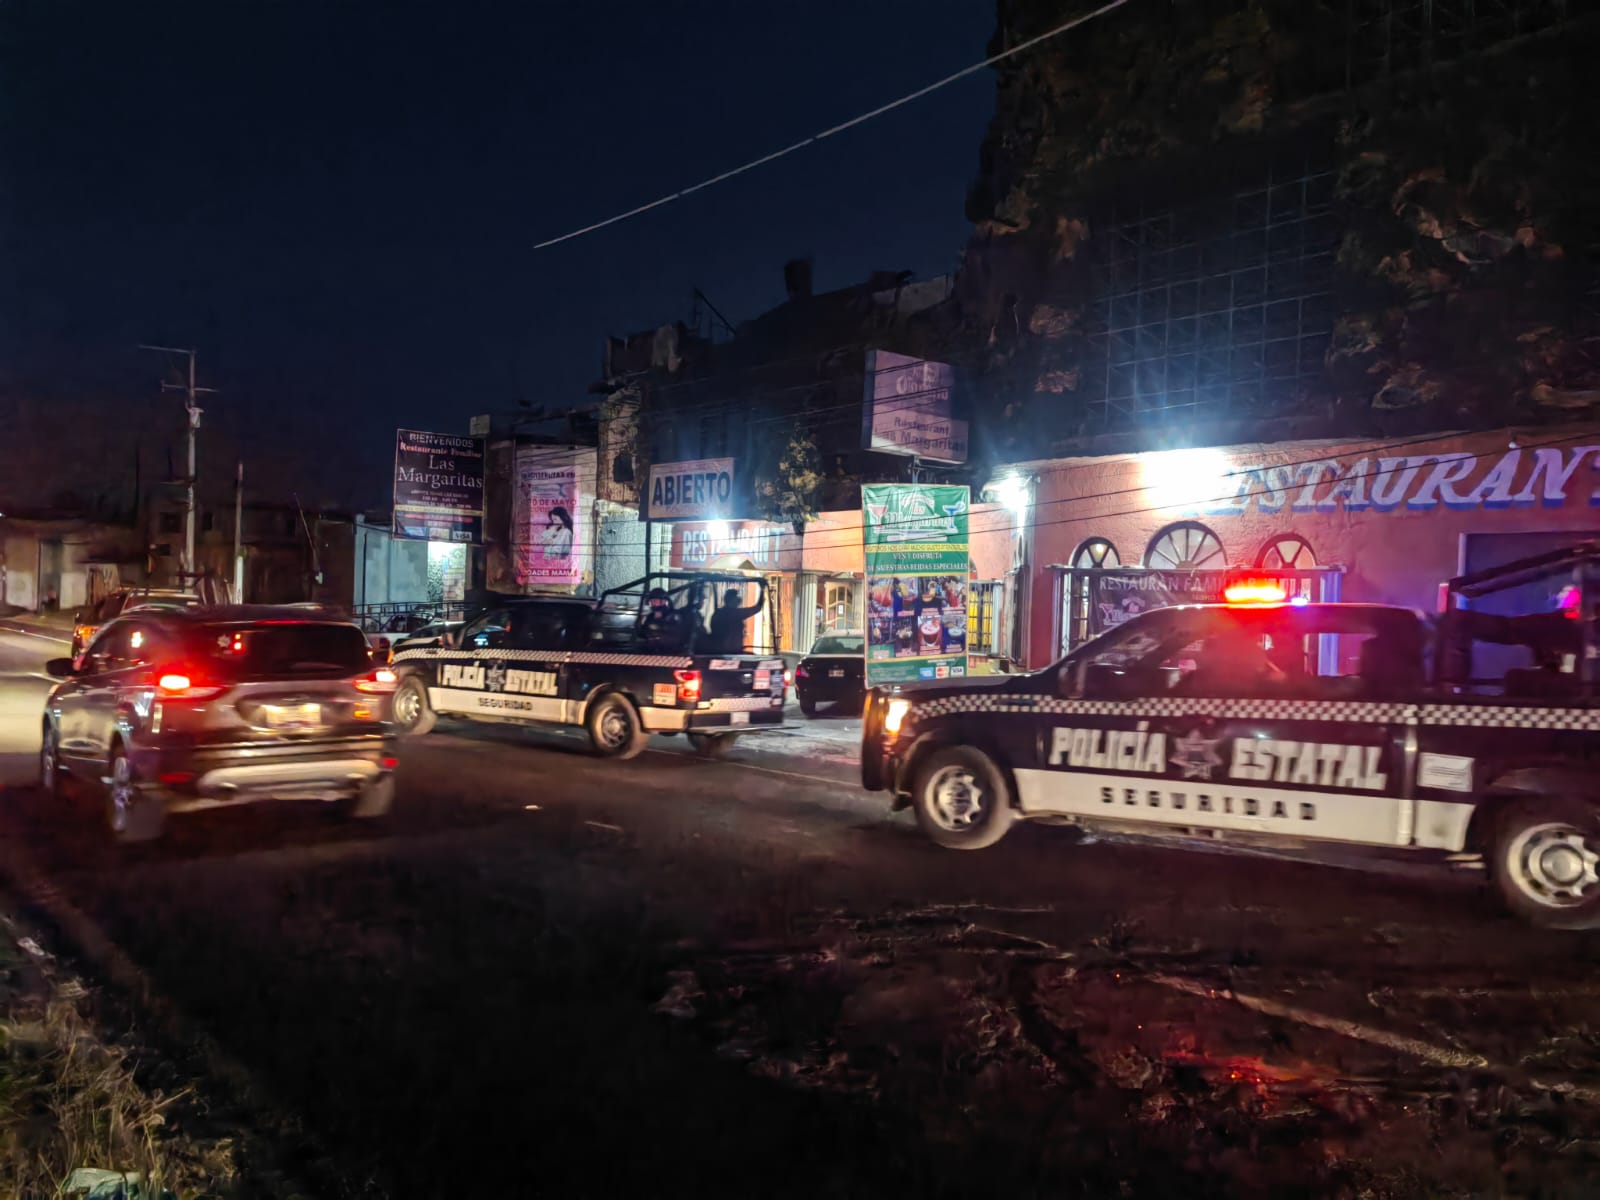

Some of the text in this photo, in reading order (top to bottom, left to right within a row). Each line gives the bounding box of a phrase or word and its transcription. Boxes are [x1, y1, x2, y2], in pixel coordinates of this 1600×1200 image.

[408, 432, 474, 448] BIENVENIDOS
[428, 454, 456, 471] Las
[398, 466, 484, 489] Margaritas
[652, 470, 732, 506] ABIERTO
[478, 697, 533, 711] SEGURIDAD
[1229, 737, 1387, 791] ESTATAL
[1101, 786, 1318, 821] SEGURIDAD
